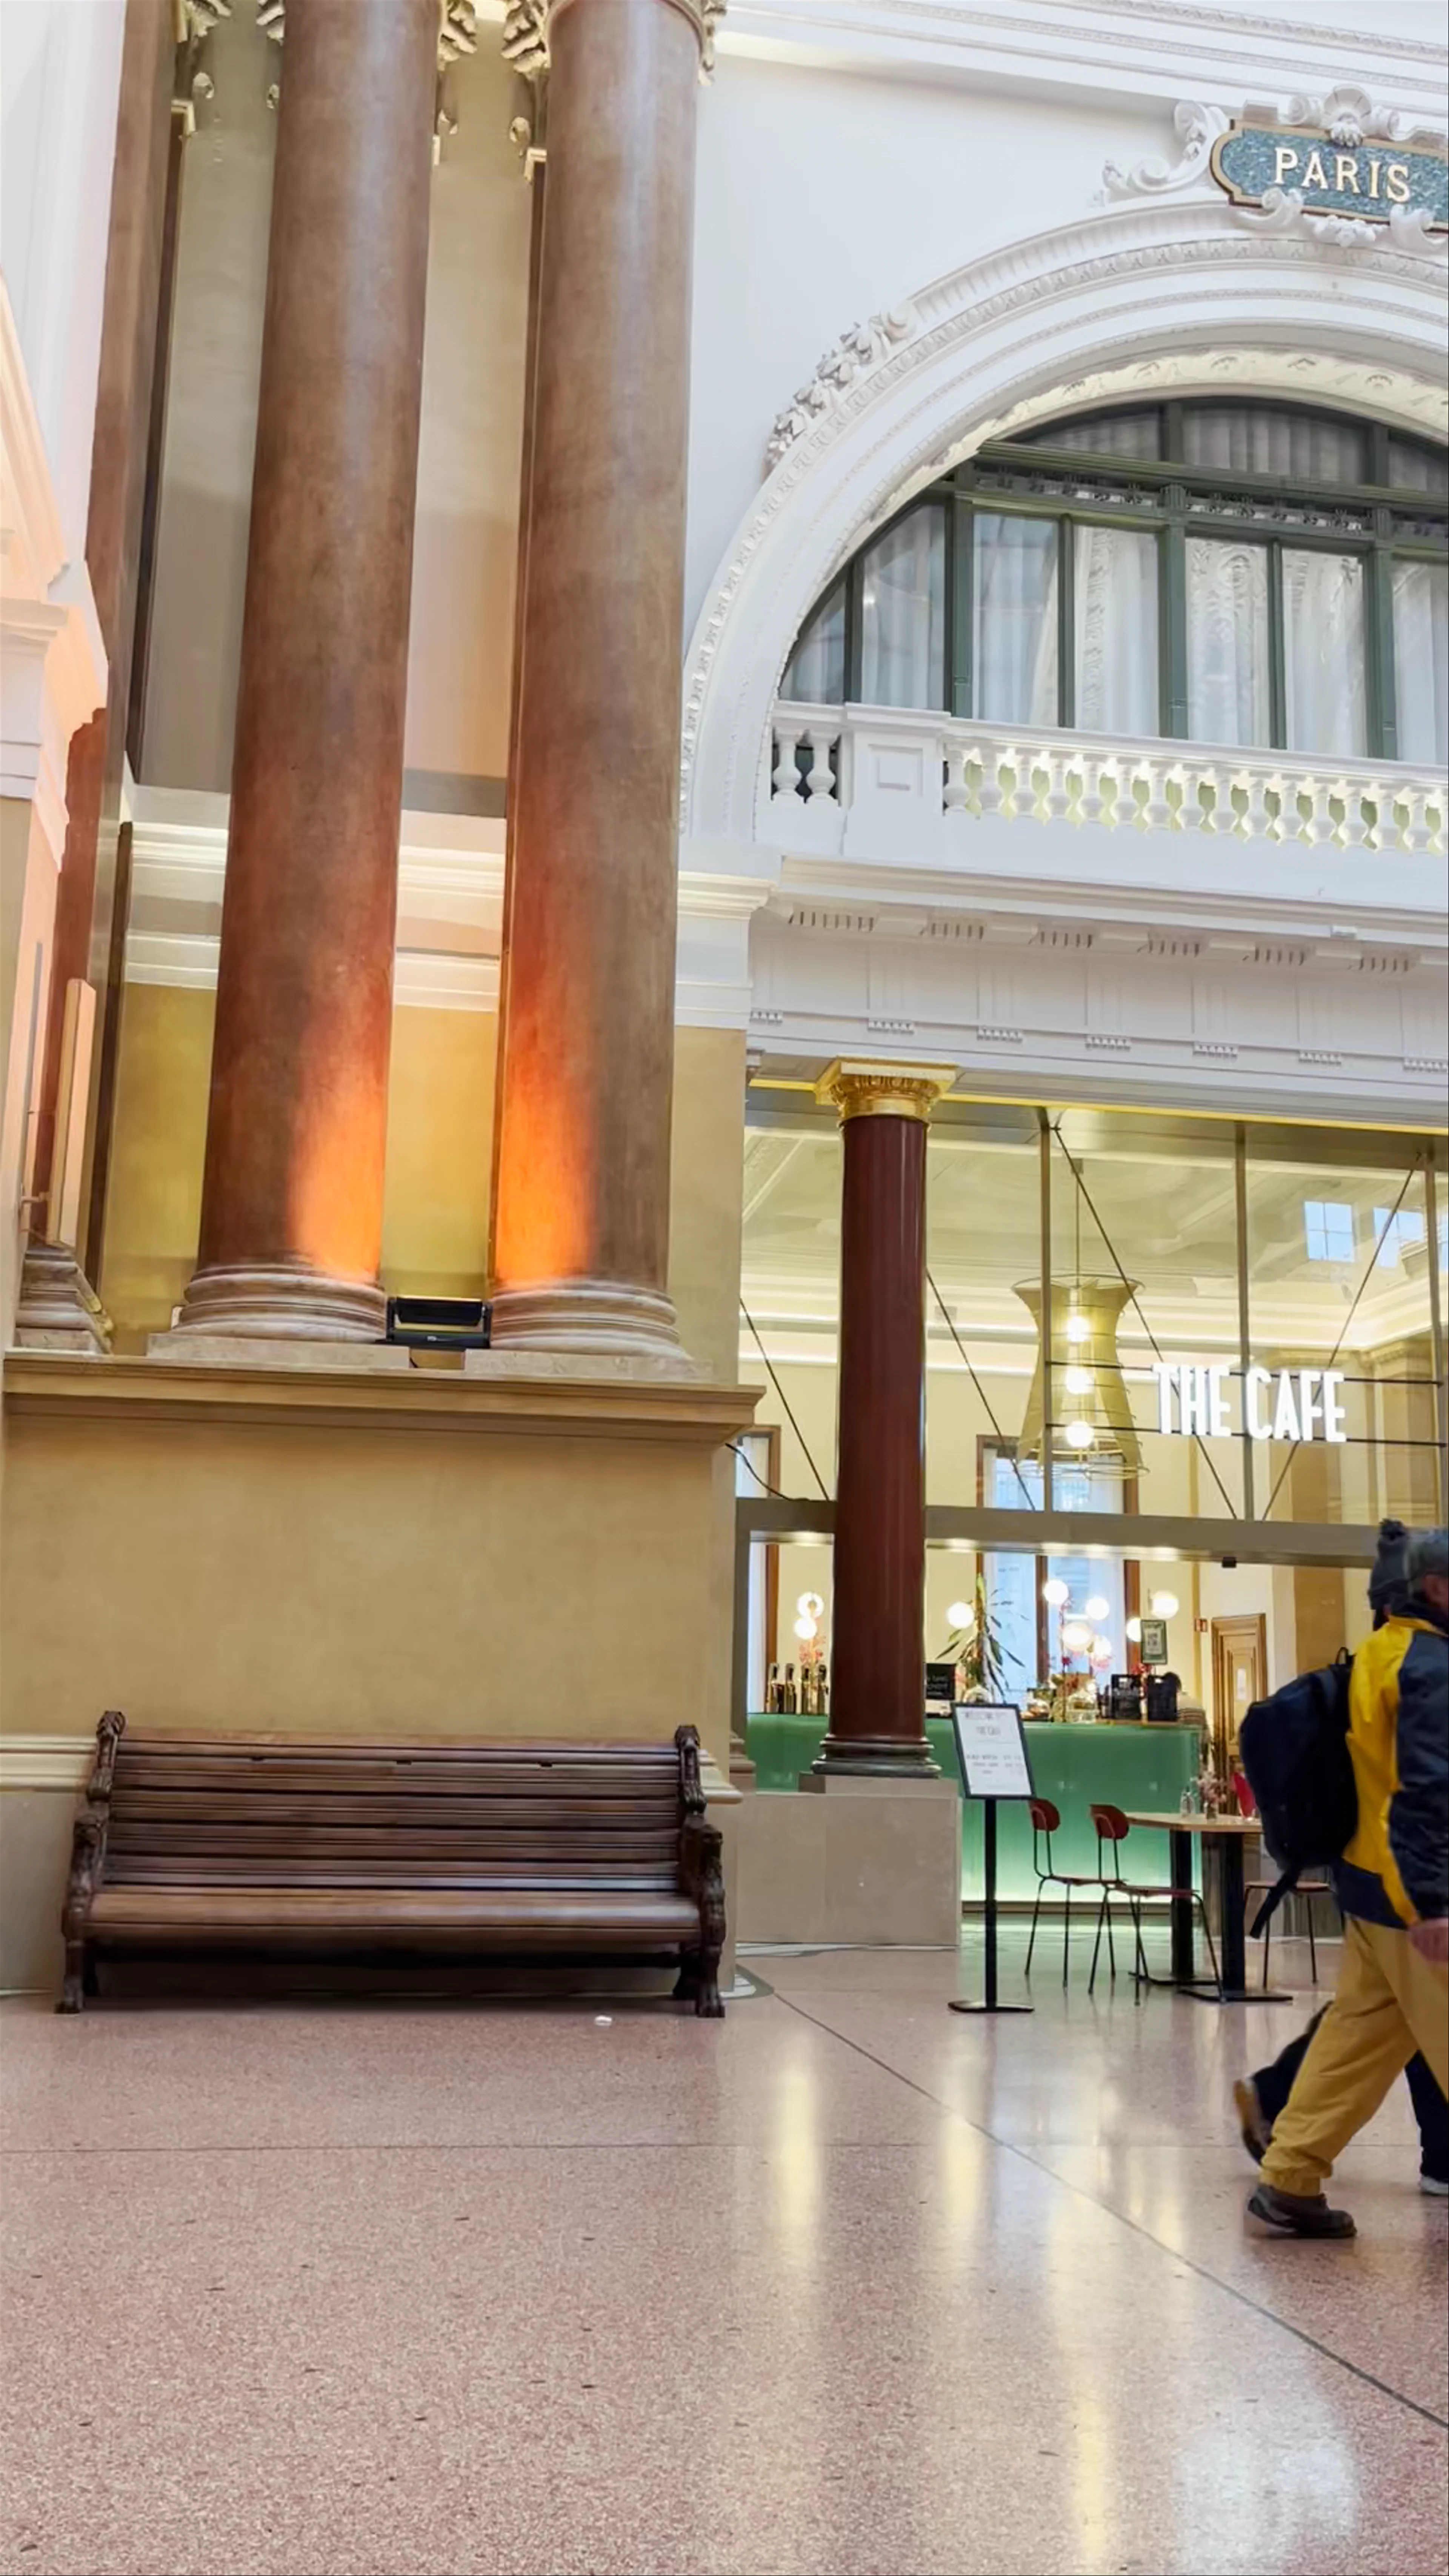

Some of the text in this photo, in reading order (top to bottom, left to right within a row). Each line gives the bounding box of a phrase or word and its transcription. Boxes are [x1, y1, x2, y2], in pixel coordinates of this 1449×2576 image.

[1275, 147, 1411, 203] PARIS
[1152, 1363, 1347, 1442] THE CAFE
